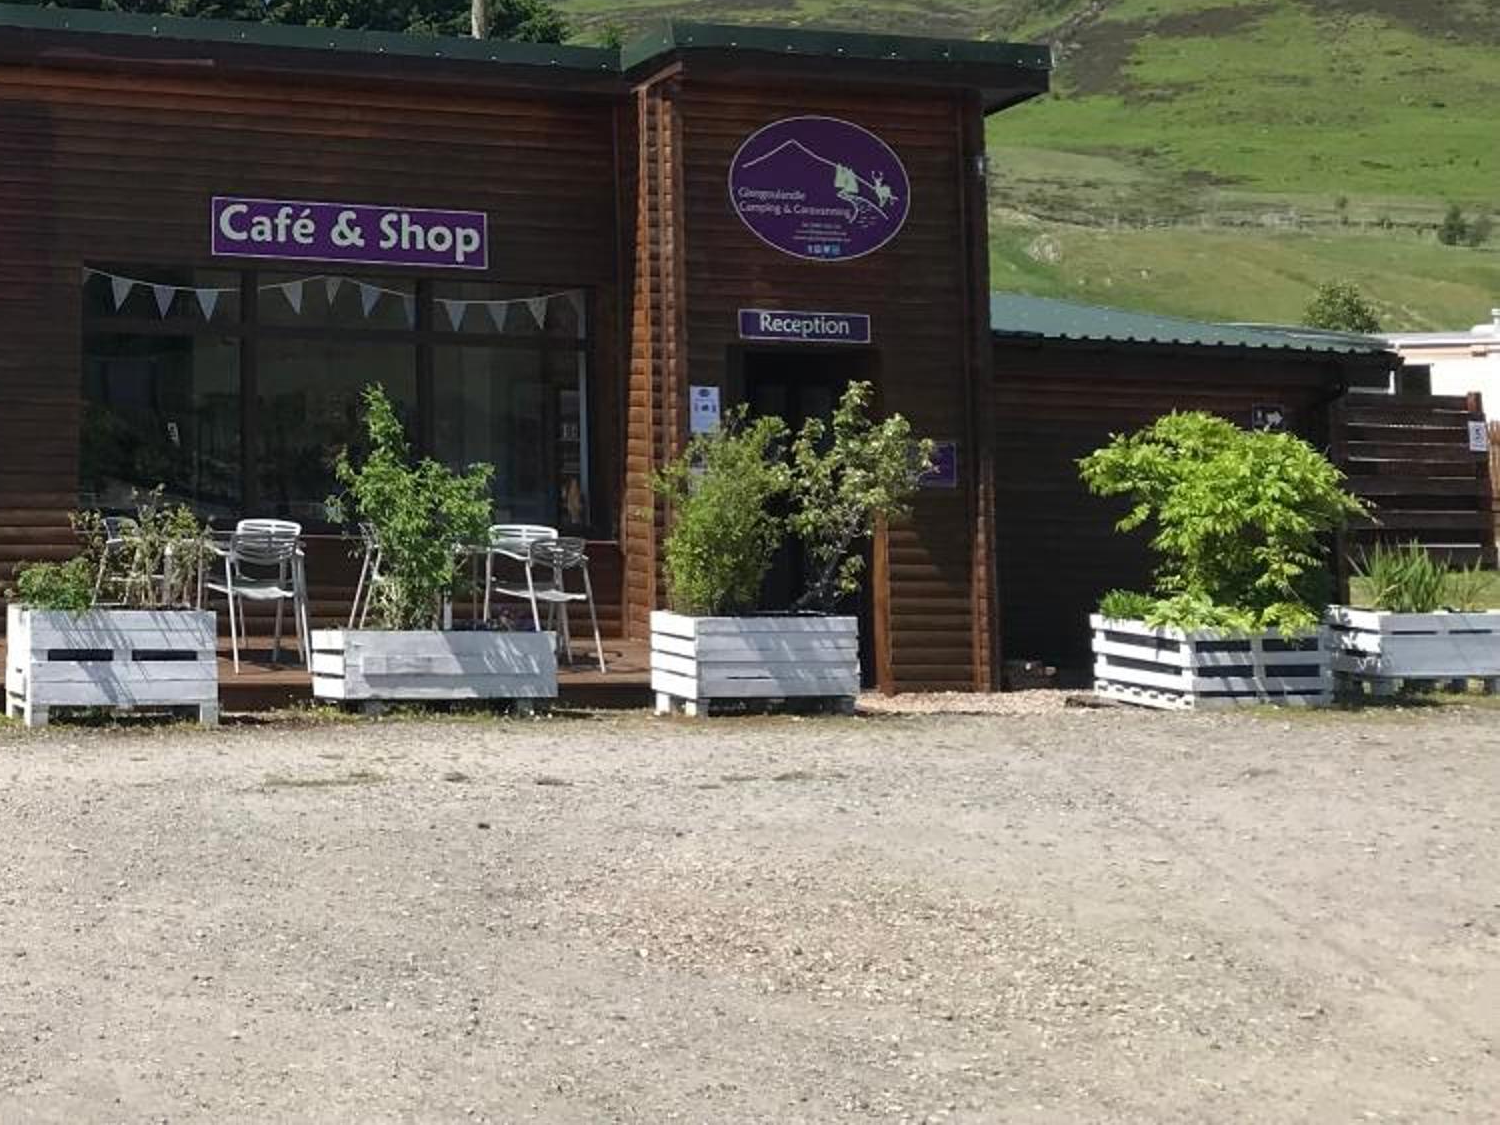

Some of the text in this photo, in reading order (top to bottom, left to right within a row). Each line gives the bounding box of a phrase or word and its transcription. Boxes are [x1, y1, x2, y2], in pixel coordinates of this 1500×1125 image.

[219, 204, 481, 262] Café & Shop
[760, 314, 850, 337] Reception
